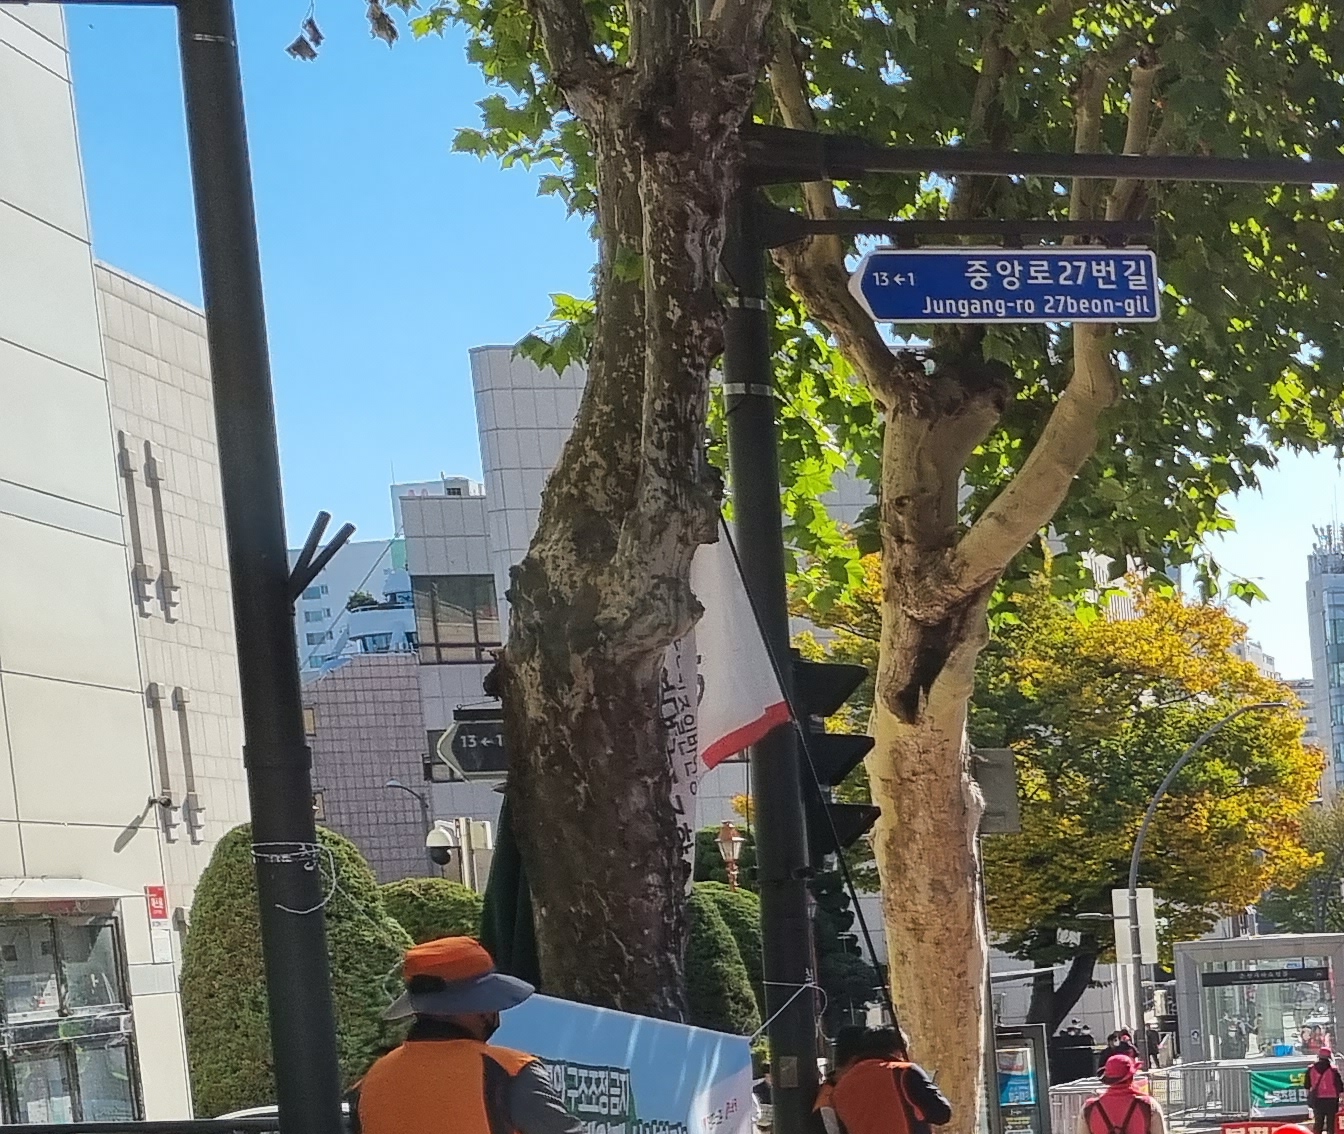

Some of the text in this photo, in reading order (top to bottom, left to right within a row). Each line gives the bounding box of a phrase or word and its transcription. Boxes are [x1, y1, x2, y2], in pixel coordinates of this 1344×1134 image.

[872, 272, 889, 287] 13
[964, 259, 1148, 291] 중앙로27번길
[922, 295, 1150, 316] Jungang-ro 27beon-gil
[460, 734, 477, 748] 13
